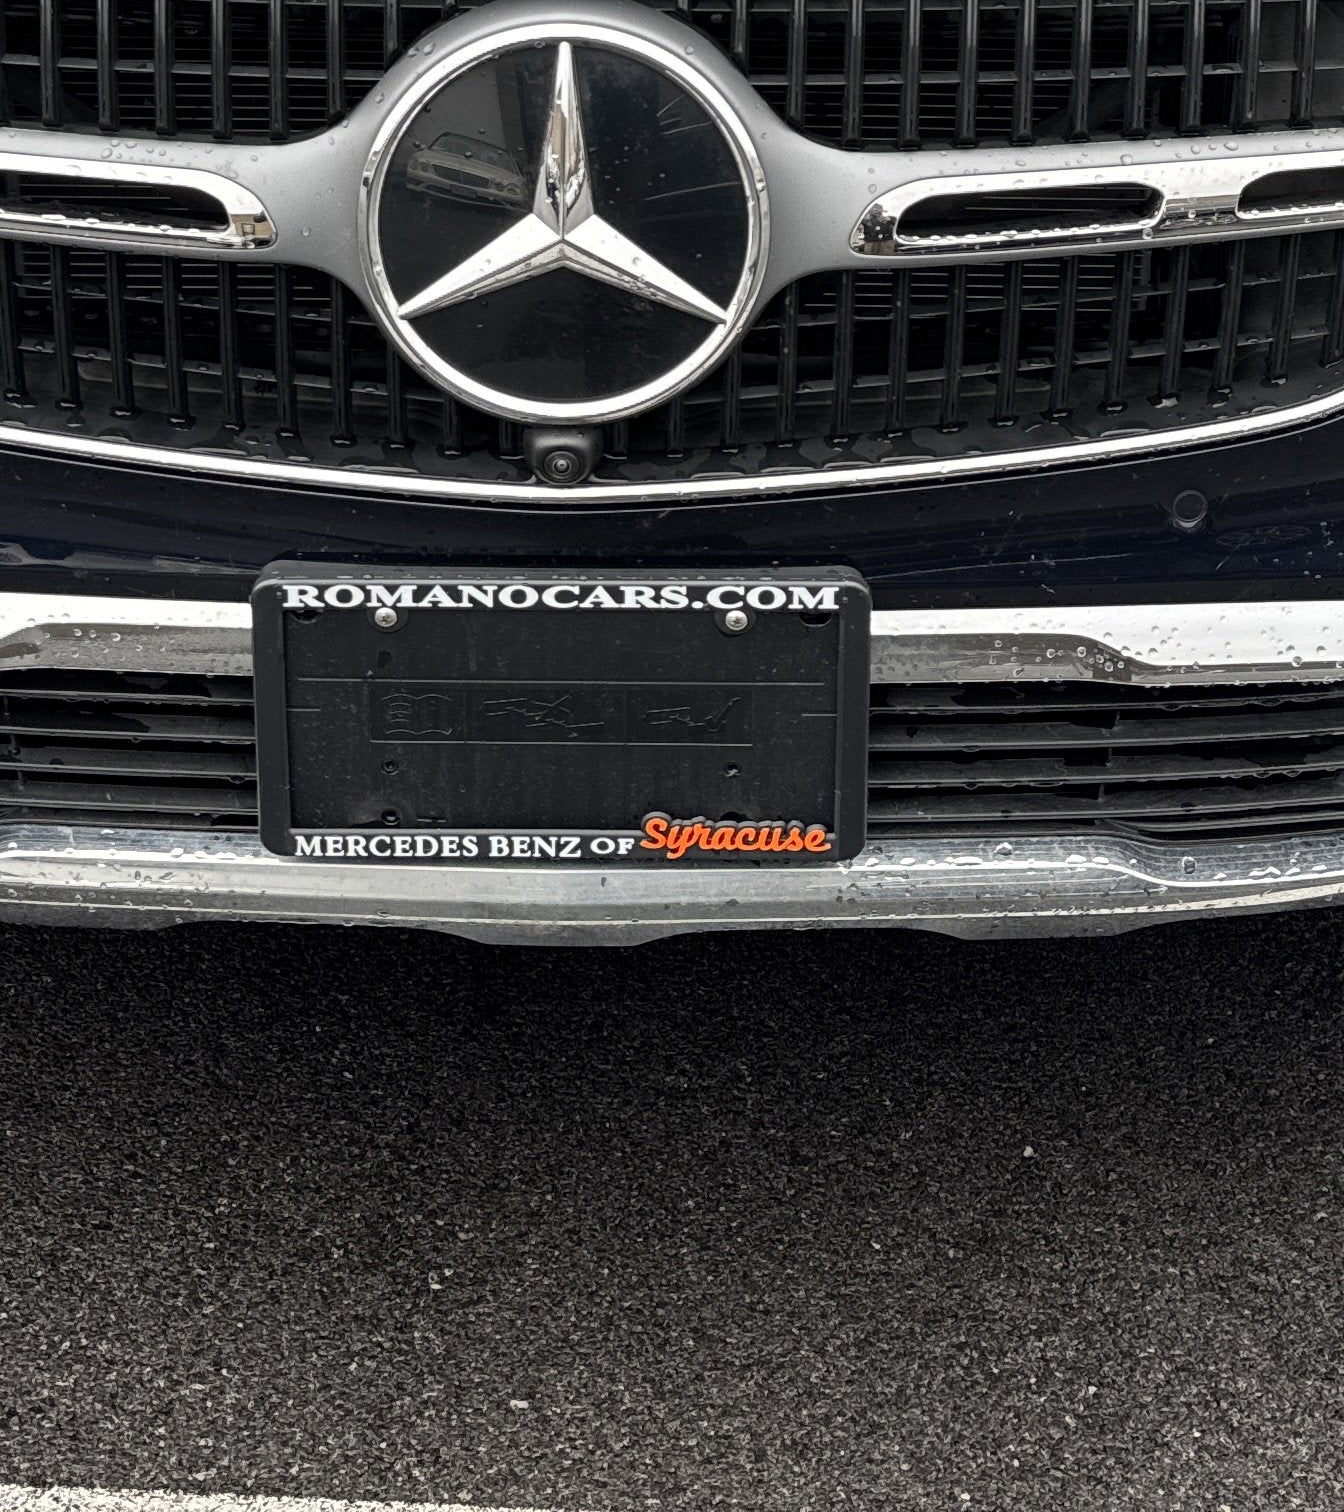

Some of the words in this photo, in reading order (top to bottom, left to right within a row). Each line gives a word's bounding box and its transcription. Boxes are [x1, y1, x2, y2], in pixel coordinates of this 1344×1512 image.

[282, 584, 840, 610] ROMANOCARS.COM
[294, 835, 479, 858] MERCEDES
[488, 836, 582, 858] BENZ
[590, 837, 635, 855] OF
[640, 816, 832, 860] Syracuse
